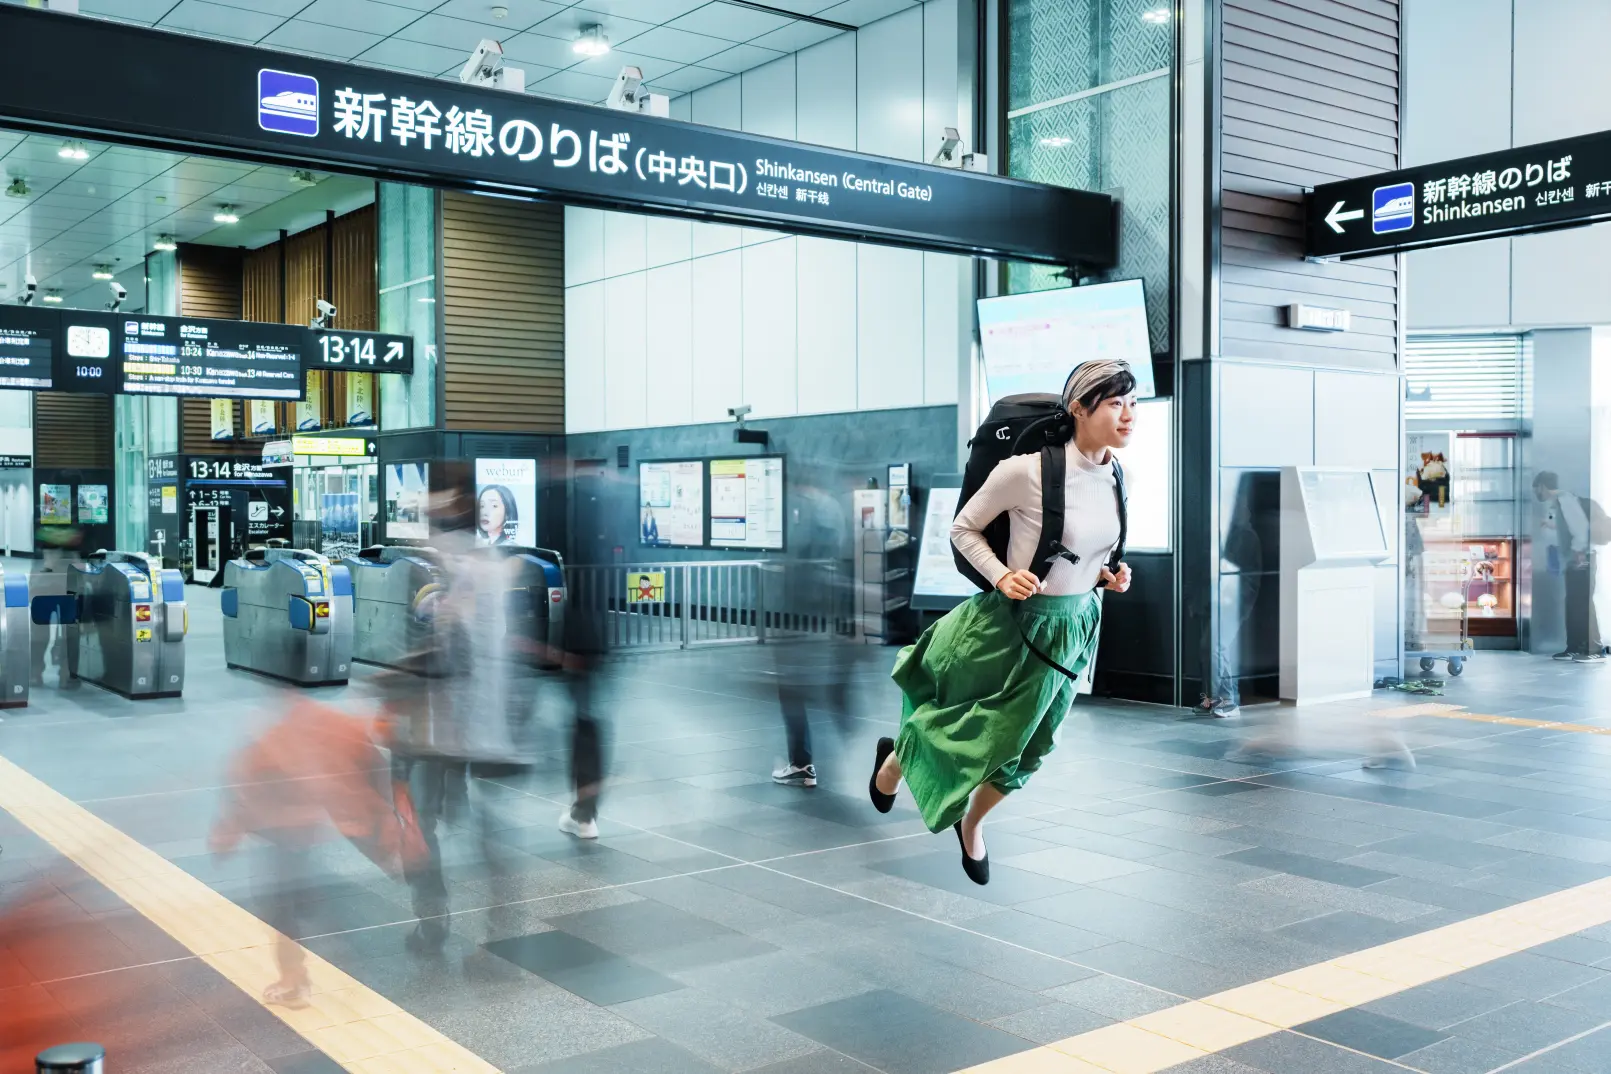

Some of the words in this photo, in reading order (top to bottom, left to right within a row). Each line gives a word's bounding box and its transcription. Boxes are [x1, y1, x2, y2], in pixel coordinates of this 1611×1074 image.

[755, 158, 838, 187] Shinkansen
[842, 171, 895, 196] (Central
[897, 182, 933, 202] Gate)
[1422, 154, 1573, 204] 新幹線のりば
[755, 182, 789, 200] 신칸센
[795, 187, 830, 206] 新干线
[1535, 186, 1575, 207] 신칸센
[1423, 195, 1526, 225] Shinkansen
[180, 347, 202, 356] 10:24
[318, 335, 377, 365] 13·14
[75, 365, 102, 377] 10:00
[180, 366, 202, 375] 10:30
[247, 369, 255, 378] 13
[190, 461, 231, 478] 13·14
